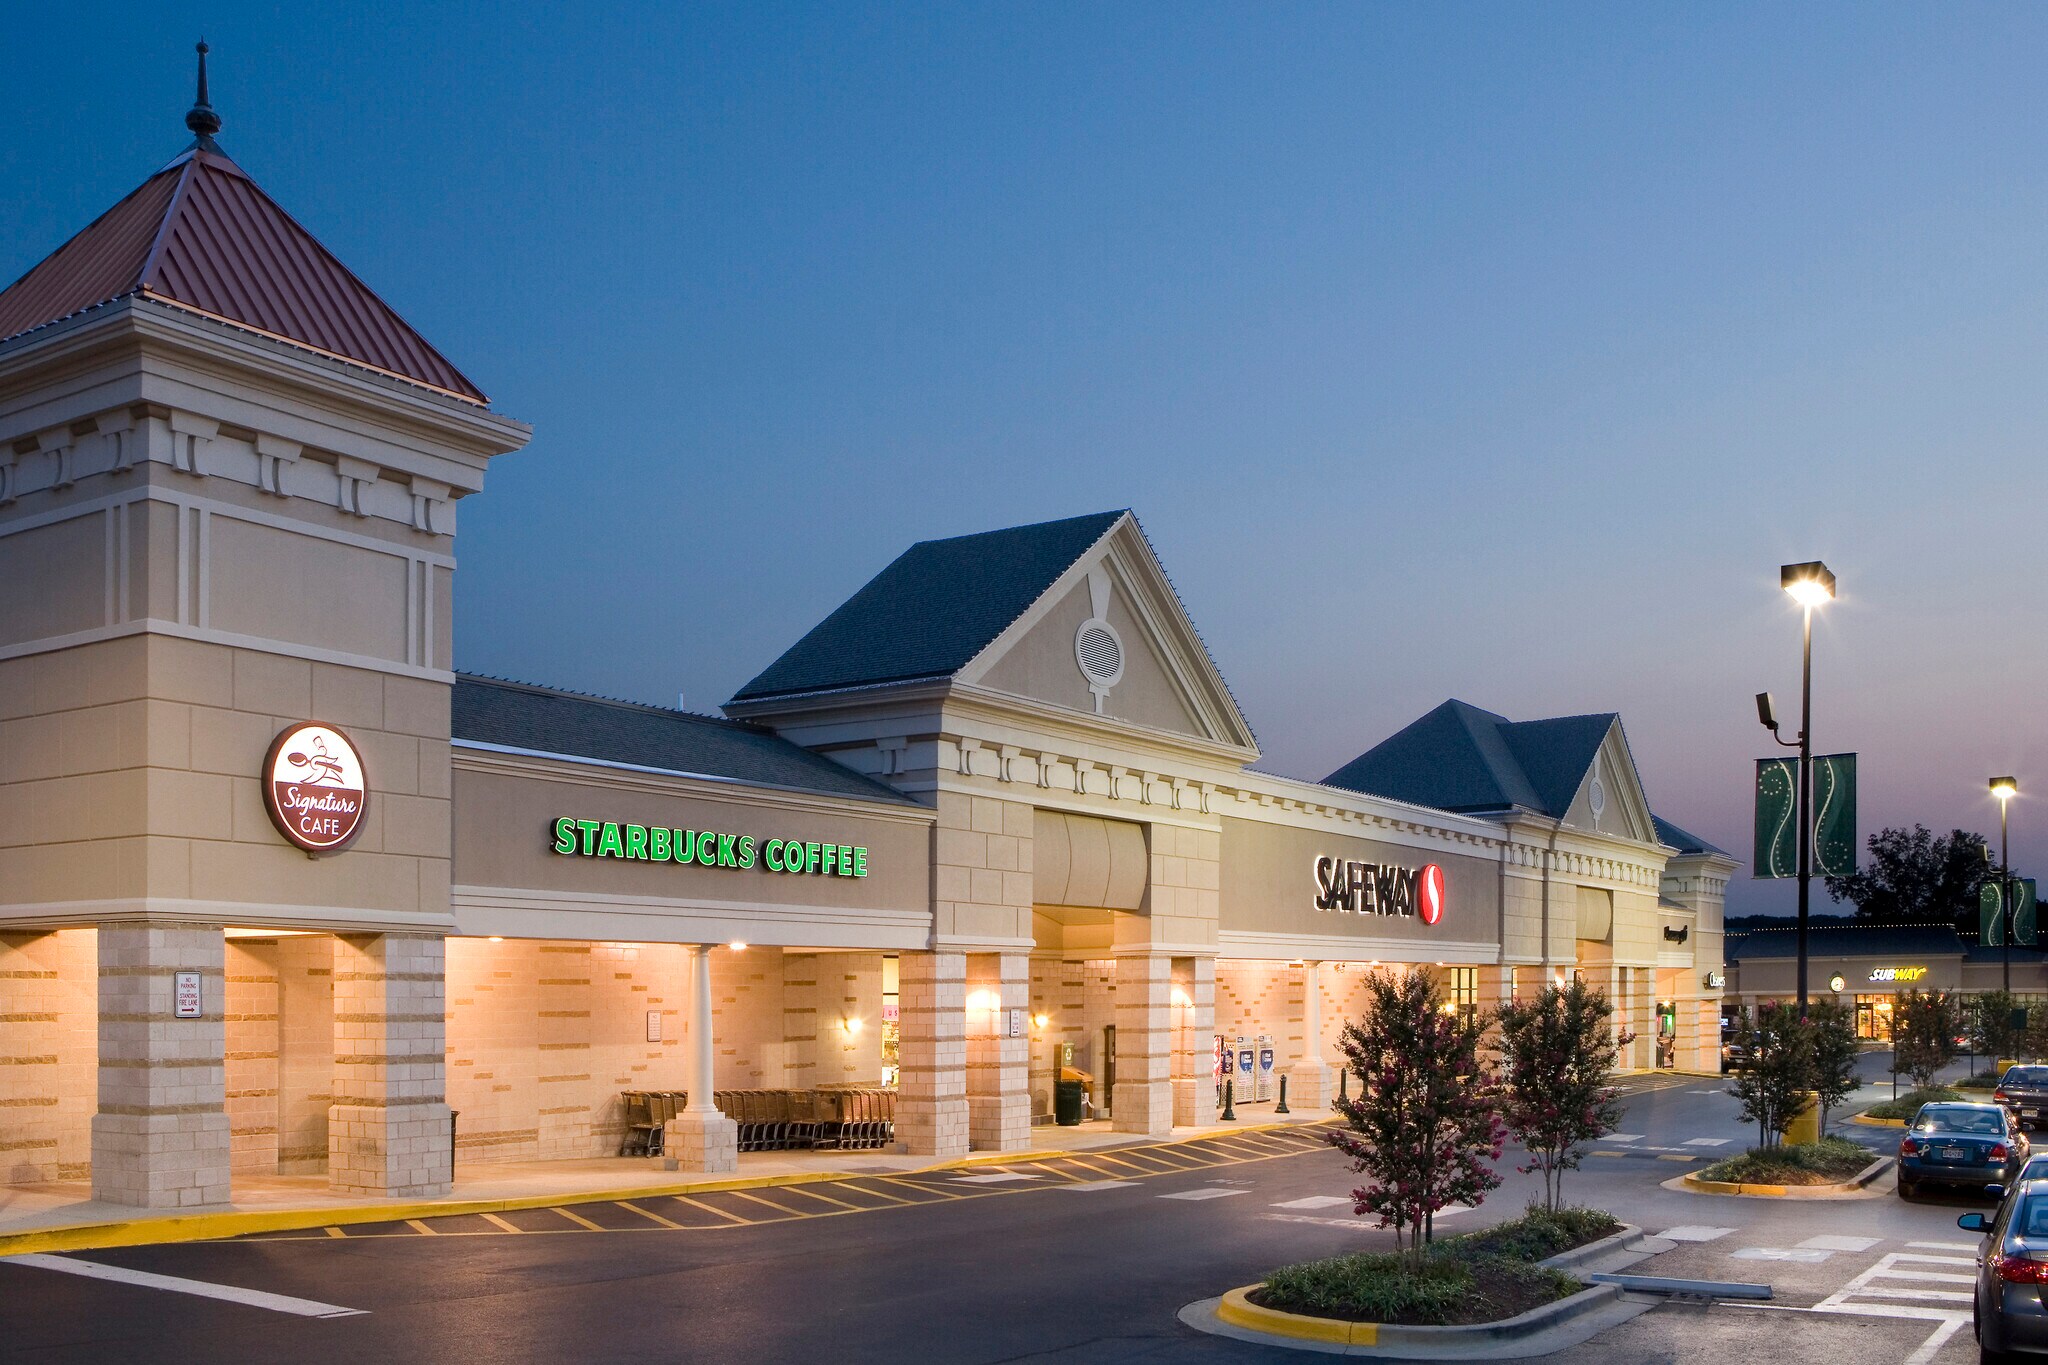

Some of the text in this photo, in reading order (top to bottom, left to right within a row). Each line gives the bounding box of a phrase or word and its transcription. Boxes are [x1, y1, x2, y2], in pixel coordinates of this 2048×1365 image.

[283, 786, 357, 816] Signature
[300, 816, 340, 835] CAFE
[554, 816, 869, 878] STARBUCKS COFFEE
[1313, 855, 1419, 918] SAFEWAY
[1868, 966, 1927, 981] SUBWAY
